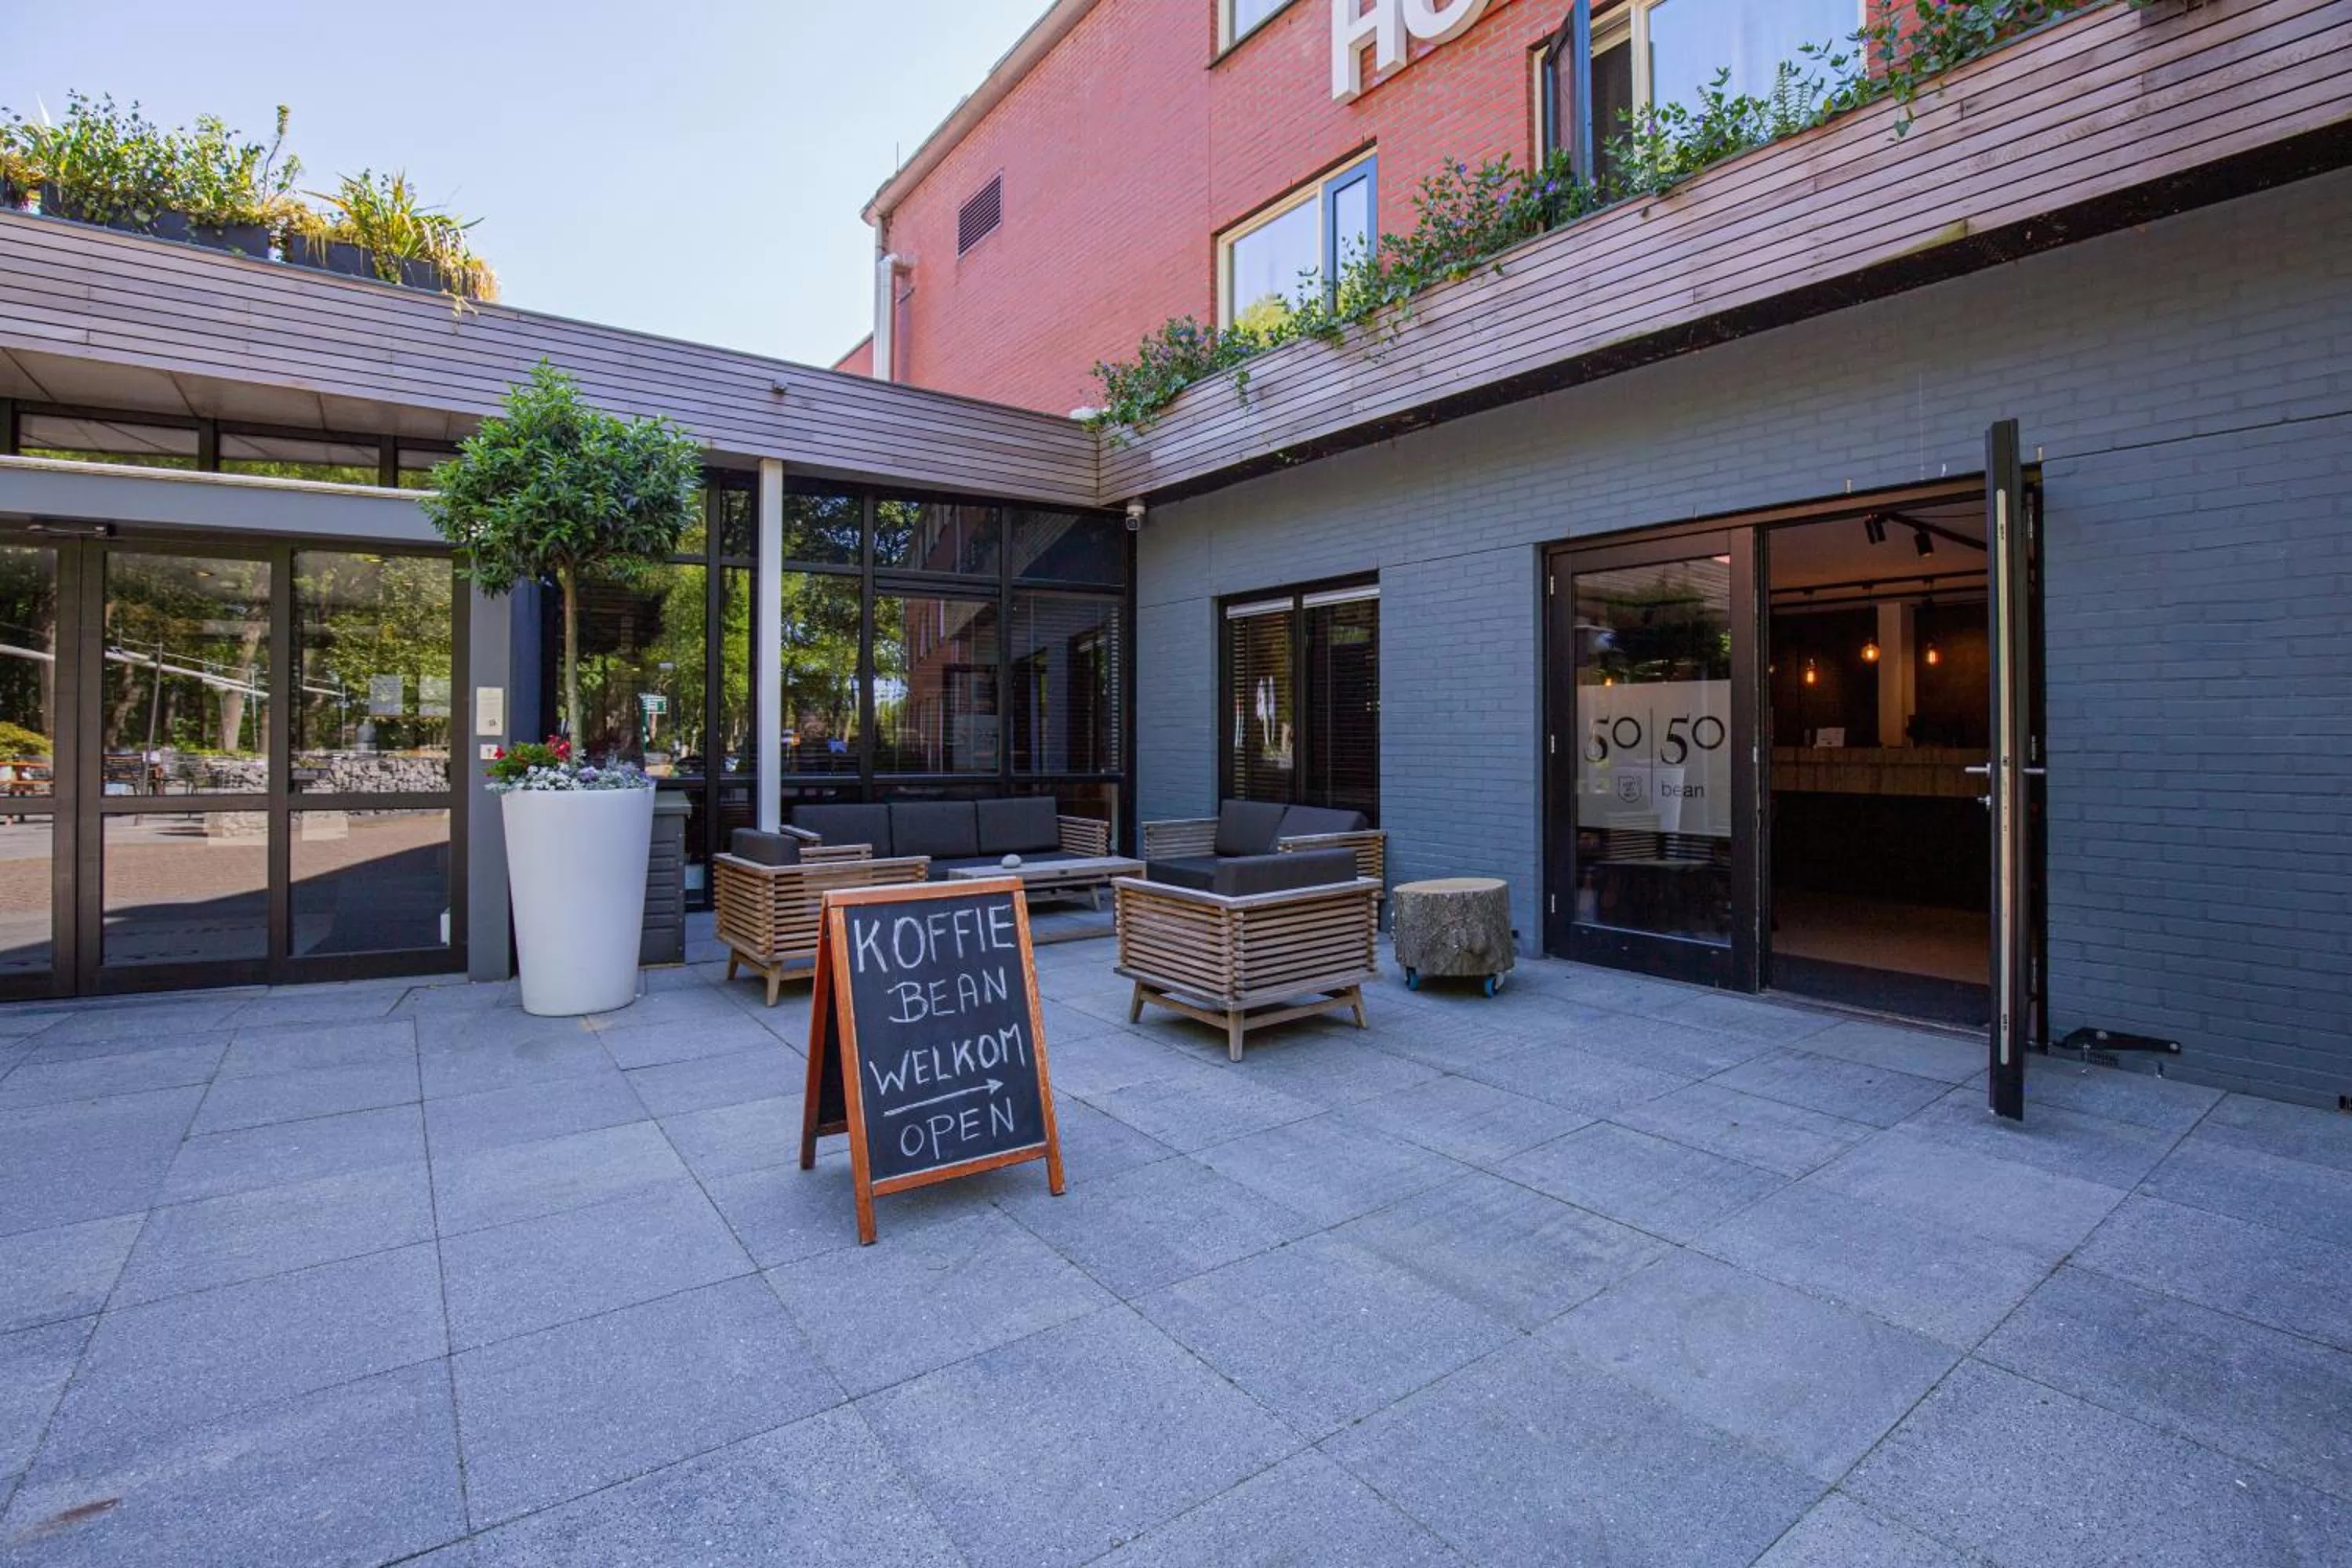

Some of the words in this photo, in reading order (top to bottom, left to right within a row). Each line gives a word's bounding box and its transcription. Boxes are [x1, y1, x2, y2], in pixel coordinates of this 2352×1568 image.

[1583, 714, 1642, 763] 50
[1660, 713, 1725, 764] 50
[1661, 780, 1705, 798] bean
[853, 905, 1015, 973] KOFFIE
[887, 966, 1007, 1023] BEAN
[868, 1022, 1026, 1096] WELKOM
[900, 1097, 1014, 1160] OPEN
